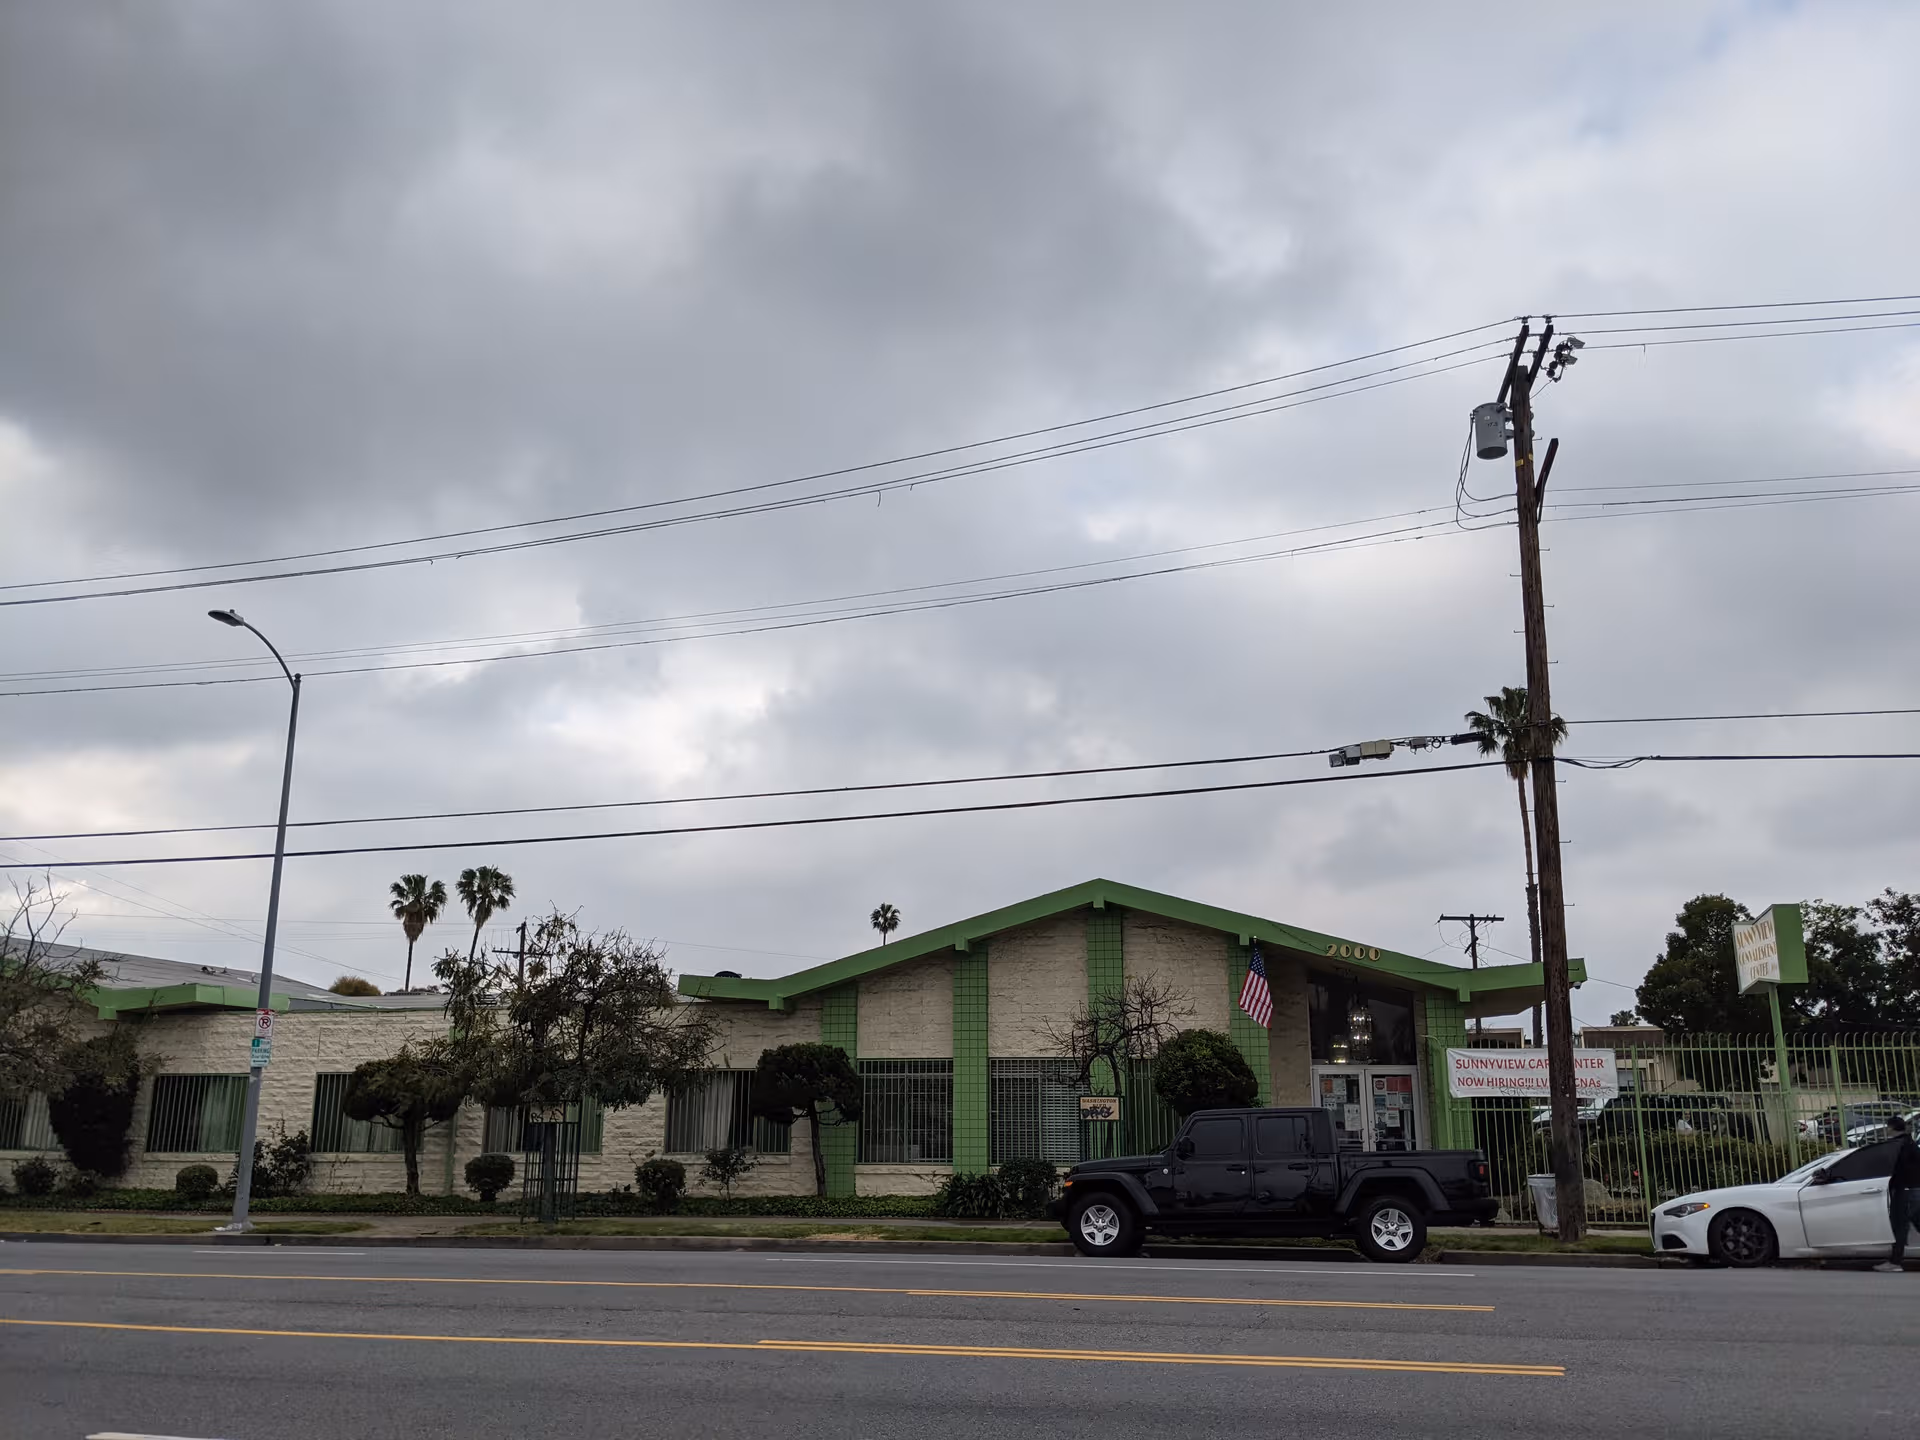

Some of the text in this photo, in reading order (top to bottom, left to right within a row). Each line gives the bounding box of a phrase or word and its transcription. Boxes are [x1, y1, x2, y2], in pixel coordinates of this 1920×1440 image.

[1326, 943, 1381, 961] 2000
[1455, 1058, 1605, 1070] SUNNYVIEW CAR NTER
[1457, 1077, 1601, 1088] NOW HIRING!!! LV CNAs
